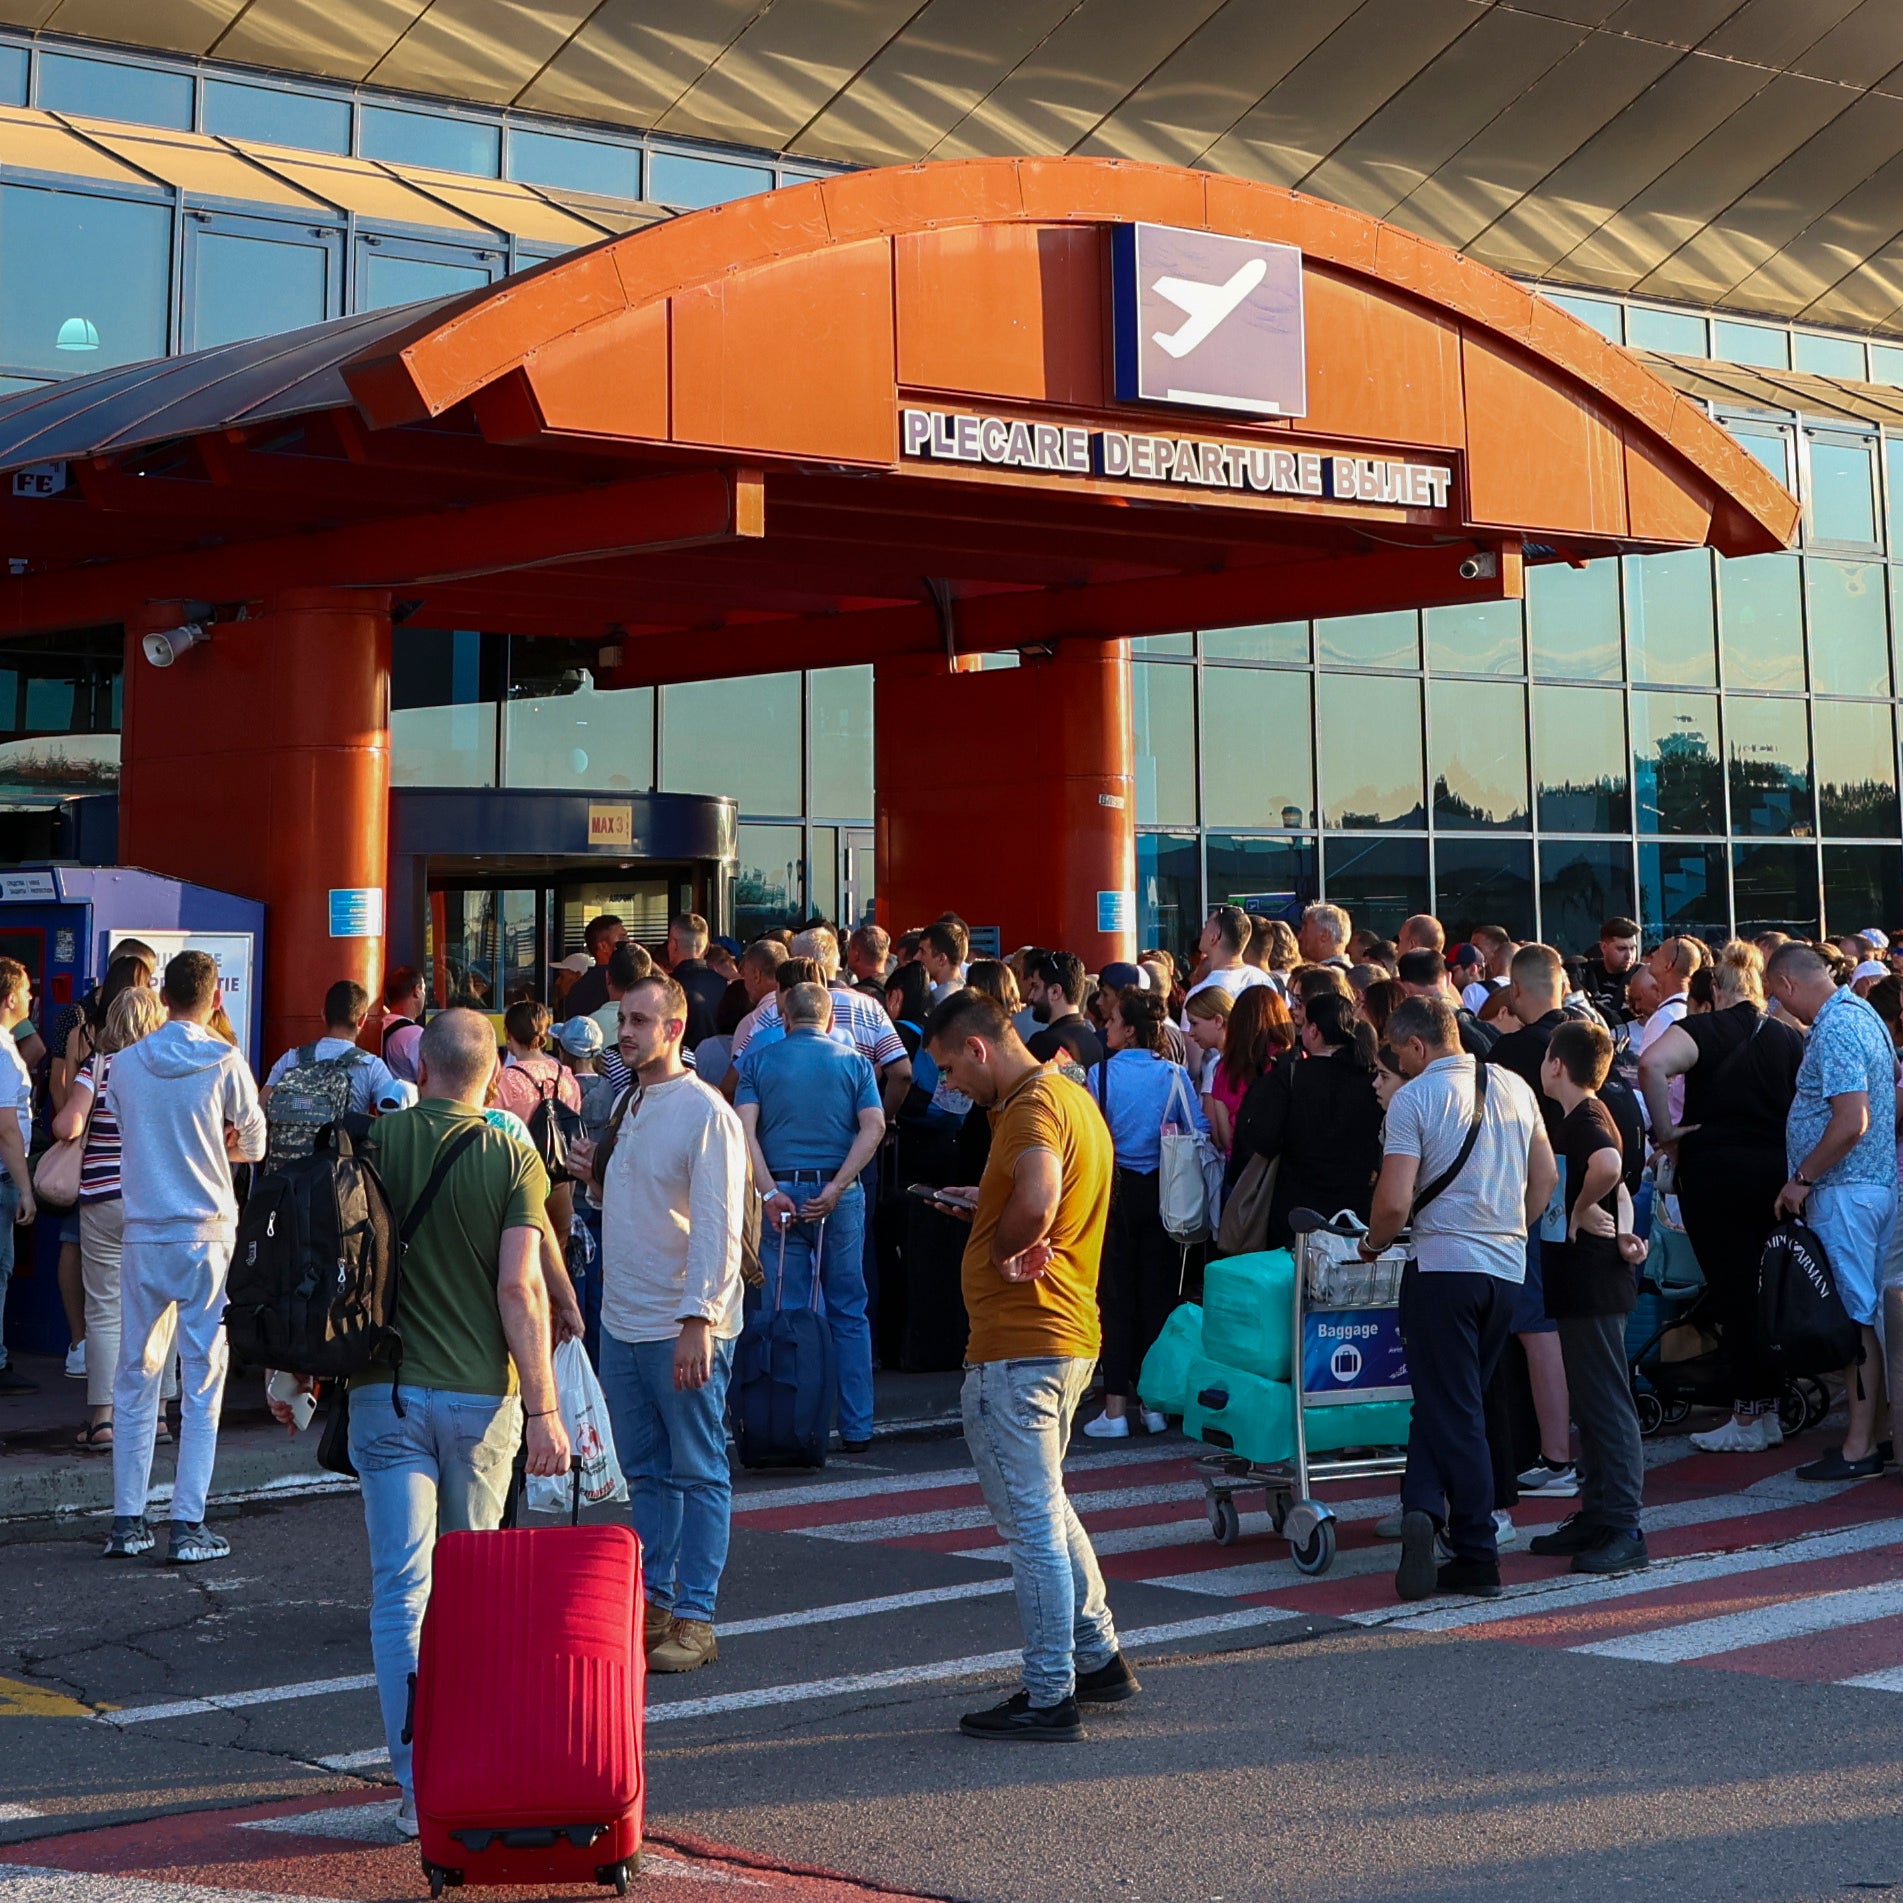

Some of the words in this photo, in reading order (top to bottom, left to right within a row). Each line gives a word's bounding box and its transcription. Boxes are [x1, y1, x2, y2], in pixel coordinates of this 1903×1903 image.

[904, 408, 1090, 473] PLECARE
[1102, 432, 1323, 496] DEPARTURE
[1333, 456, 1452, 508] ВЫЛЕТ
[592, 816, 614, 834] MAX
[1318, 1323, 1379, 1340] Baggage
